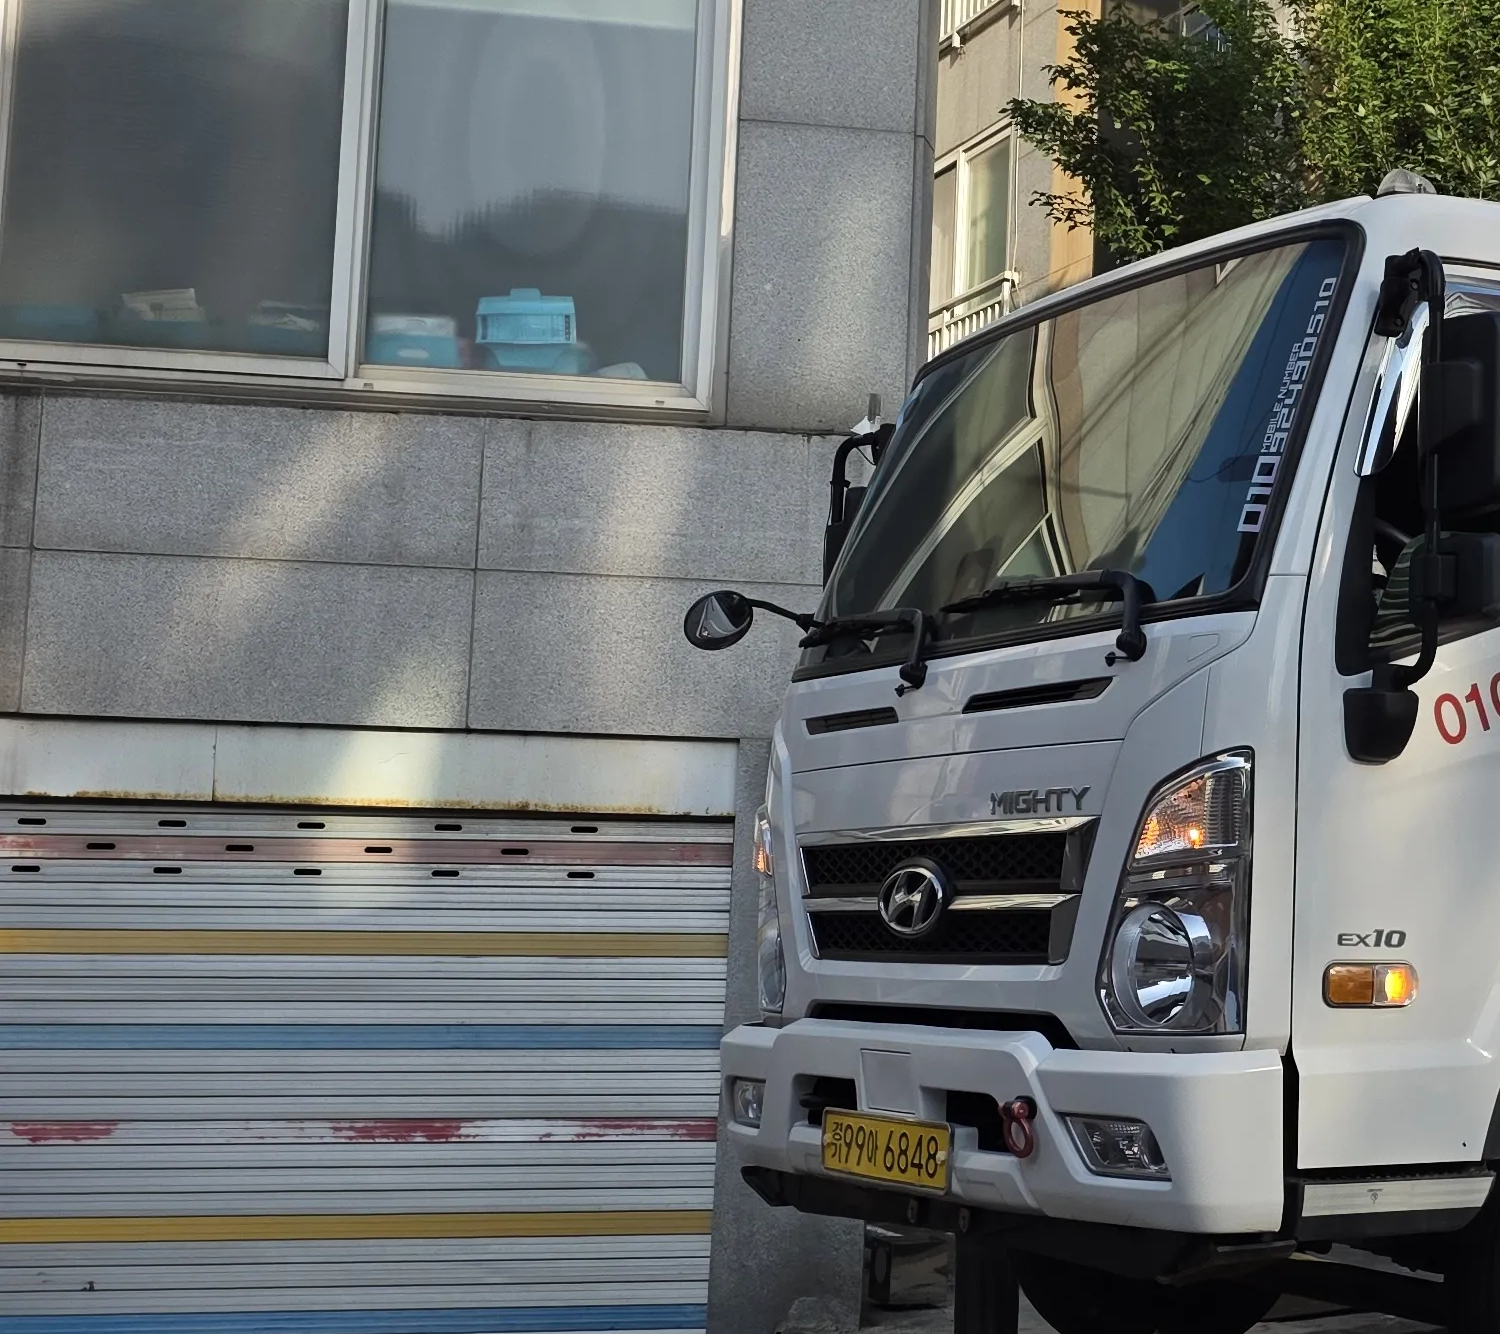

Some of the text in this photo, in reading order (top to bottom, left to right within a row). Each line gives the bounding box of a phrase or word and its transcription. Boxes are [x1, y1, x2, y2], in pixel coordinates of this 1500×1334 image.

[1261, 342, 1302, 452] MOBILE NUMBER
[990, 785, 1091, 815] MIGHTY
[1337, 928, 1407, 948] EX10
[883, 1130, 939, 1179] 6848
